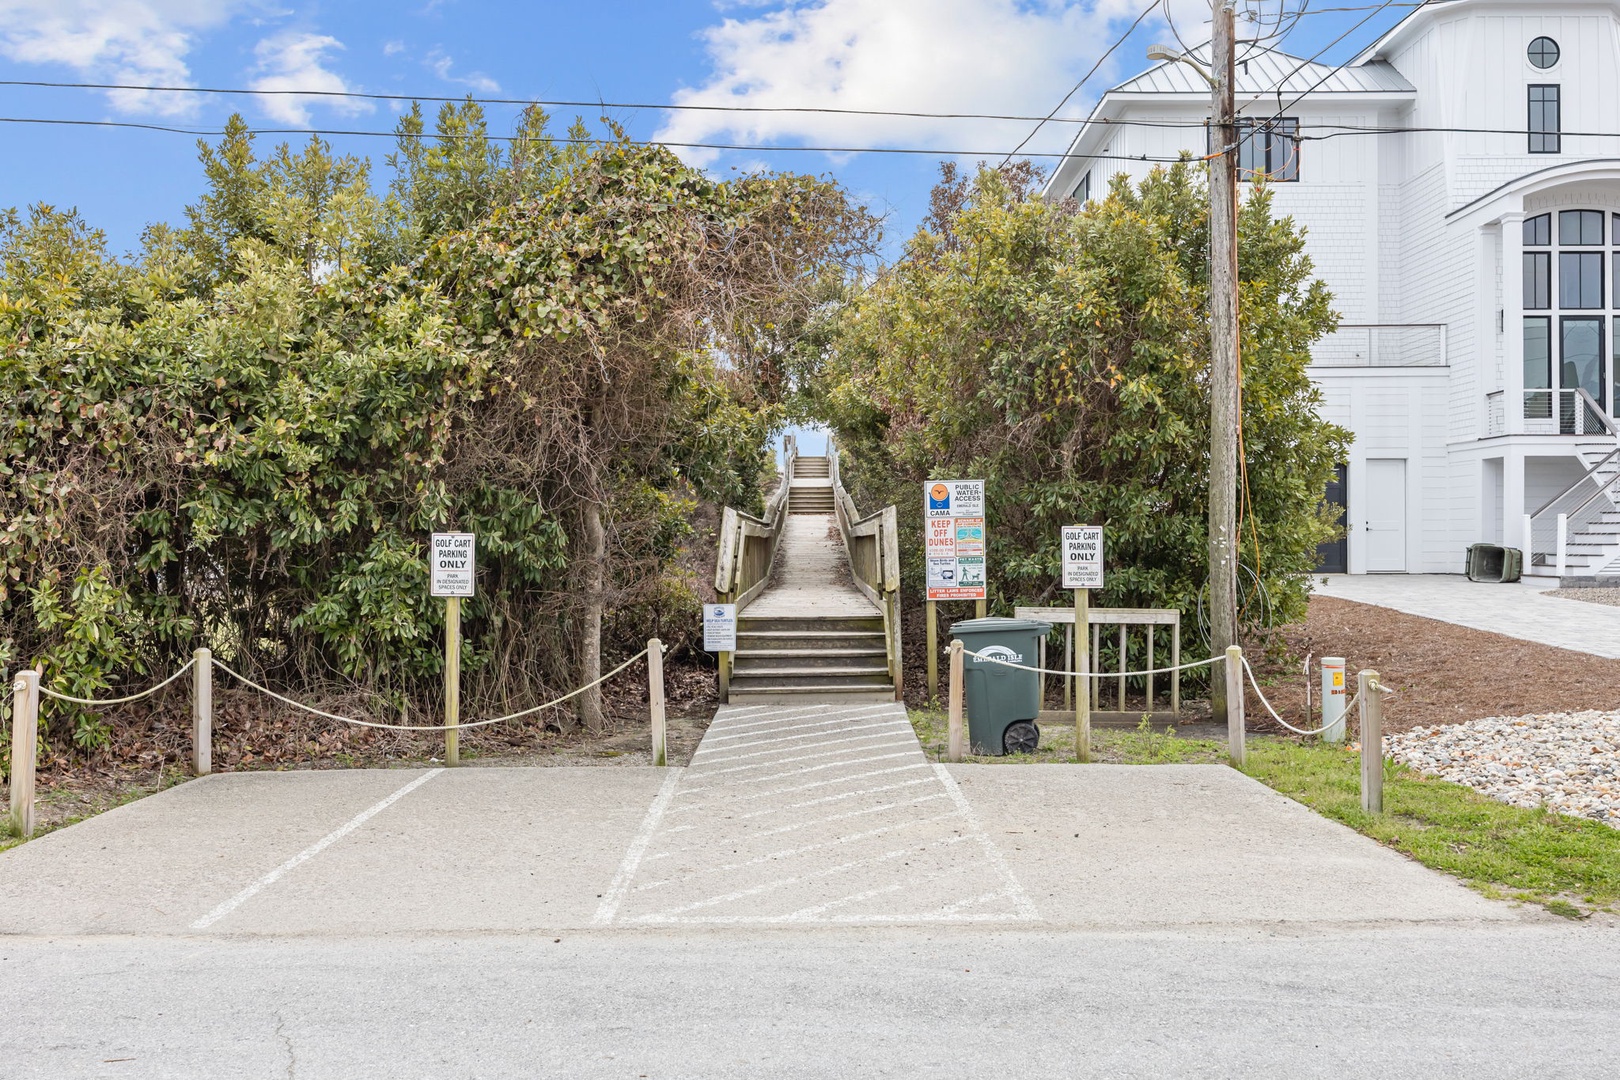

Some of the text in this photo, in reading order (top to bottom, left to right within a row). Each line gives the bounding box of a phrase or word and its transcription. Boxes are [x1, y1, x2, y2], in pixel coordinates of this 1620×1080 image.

[931, 520, 950, 528] KEEP
[1065, 532, 1099, 540] GOLF CART
[435, 539, 452, 547] GOLF
[929, 538, 954, 546] DUNES
[1069, 542, 1096, 550] PARKING
[439, 550, 467, 558] PARKING
